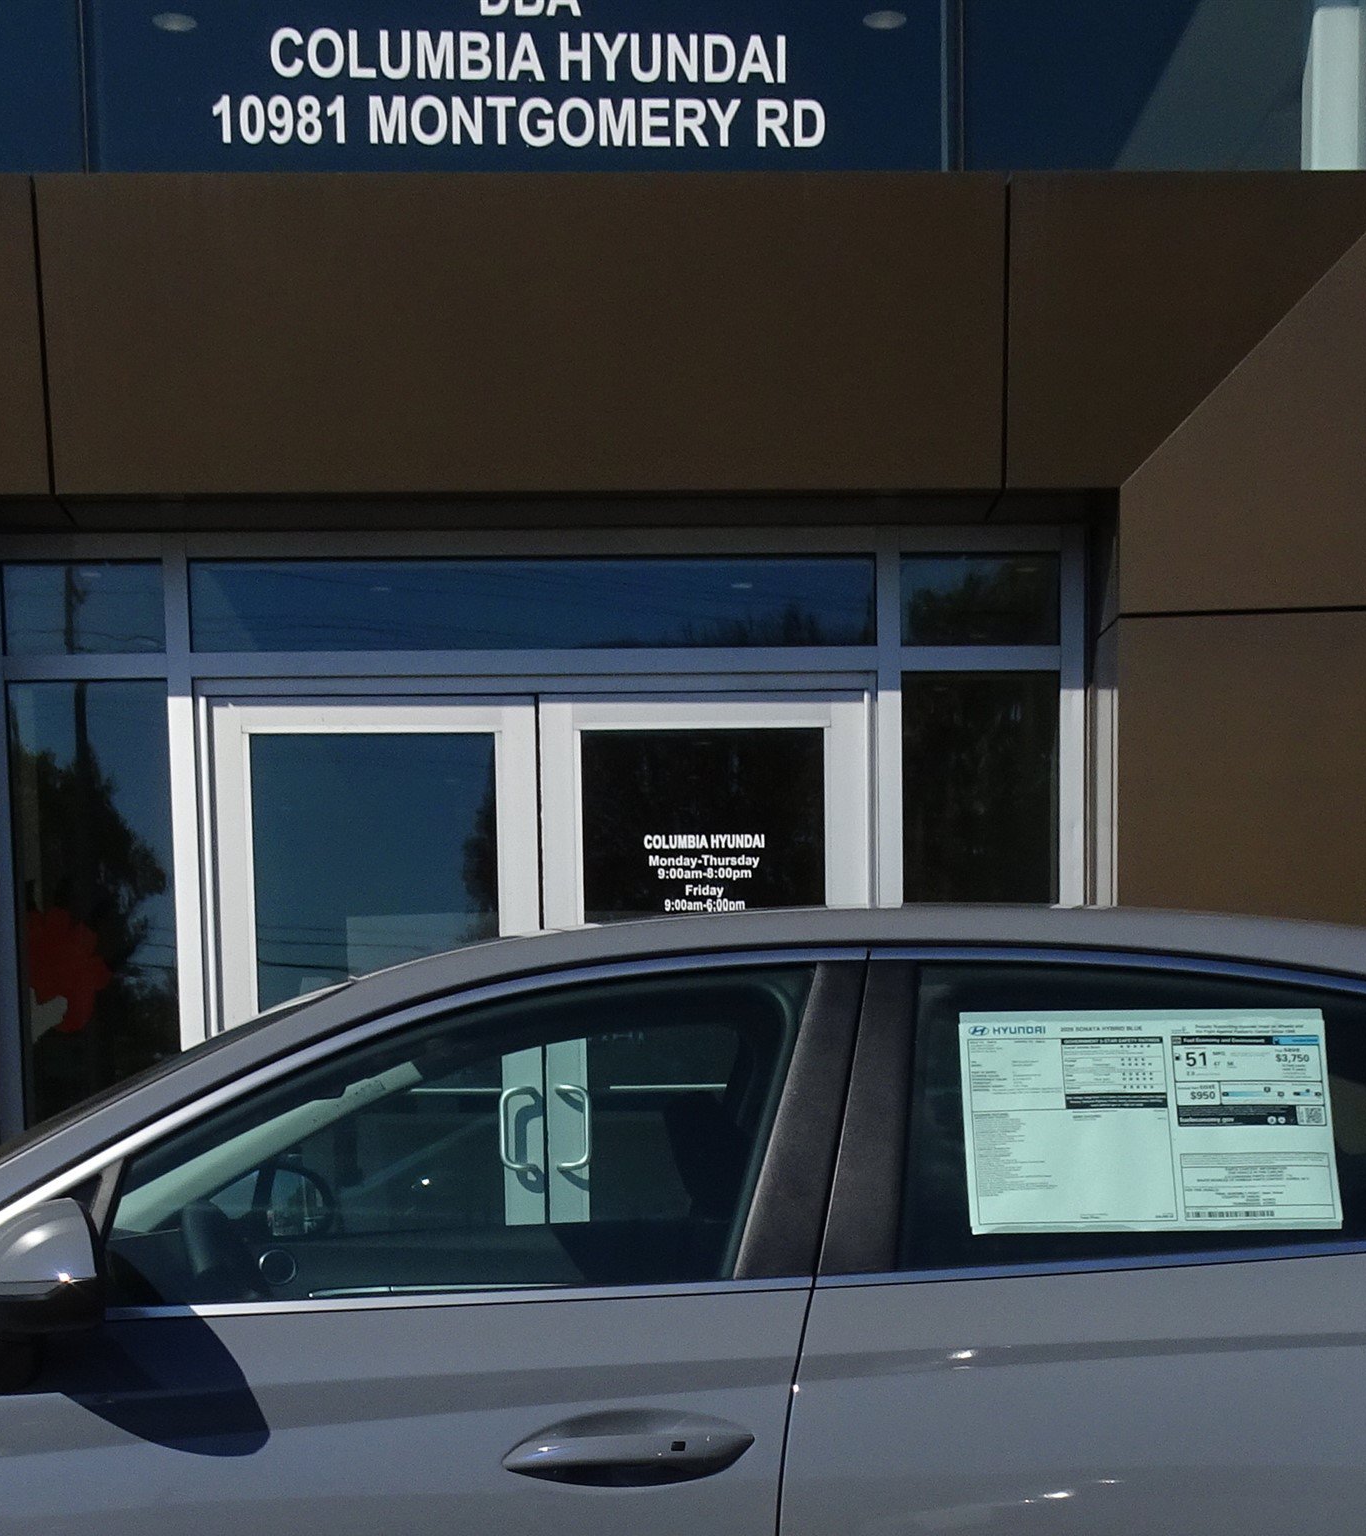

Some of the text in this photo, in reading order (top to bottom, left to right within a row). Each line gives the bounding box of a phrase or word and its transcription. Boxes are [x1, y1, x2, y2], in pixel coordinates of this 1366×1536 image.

[271, 27, 785, 83] COLUMBIA HYUNDAI
[213, 95, 825, 147] 10981 MONTGOMERY RD
[644, 834, 765, 849] COLUMBIA HYUNDAI
[649, 855, 759, 869] Monday-Thursday
[657, 868, 752, 880] 9:00am-8:00pm
[685, 884, 724, 898] Friday
[992, 1026, 1046, 1034] HYUNDAI
[1186, 1052, 1207, 1067] 51
[1275, 1054, 1310, 1063] $3,750
[1190, 1091, 1216, 1101] $950
